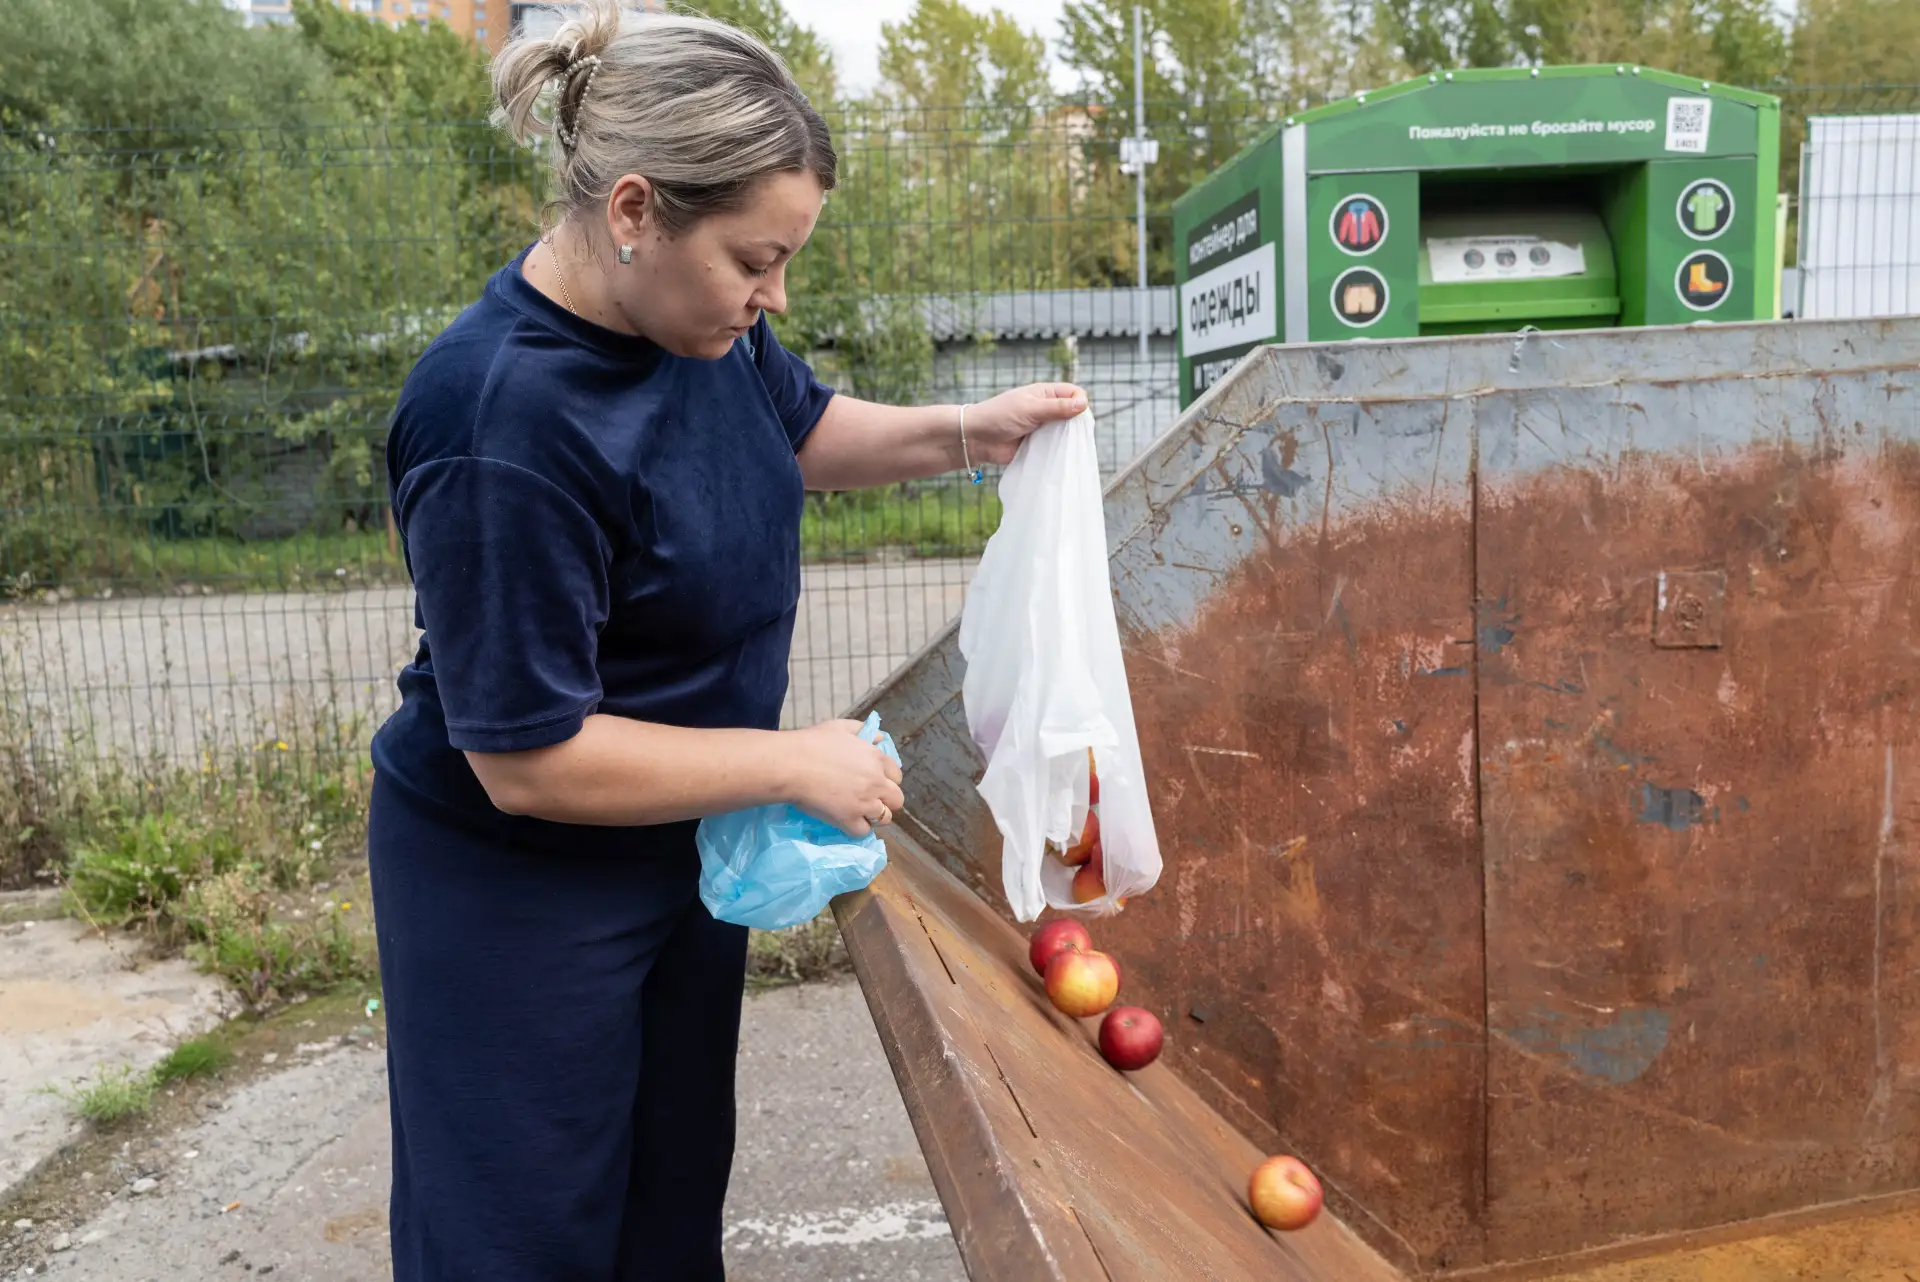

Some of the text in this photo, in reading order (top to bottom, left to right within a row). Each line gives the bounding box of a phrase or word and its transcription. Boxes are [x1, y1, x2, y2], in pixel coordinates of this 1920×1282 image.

[1409, 119, 1655, 140] Пожалуйста не бросайте мусор
[1189, 208, 1257, 266] контейнер для
[1190, 270, 1260, 337] одежды
